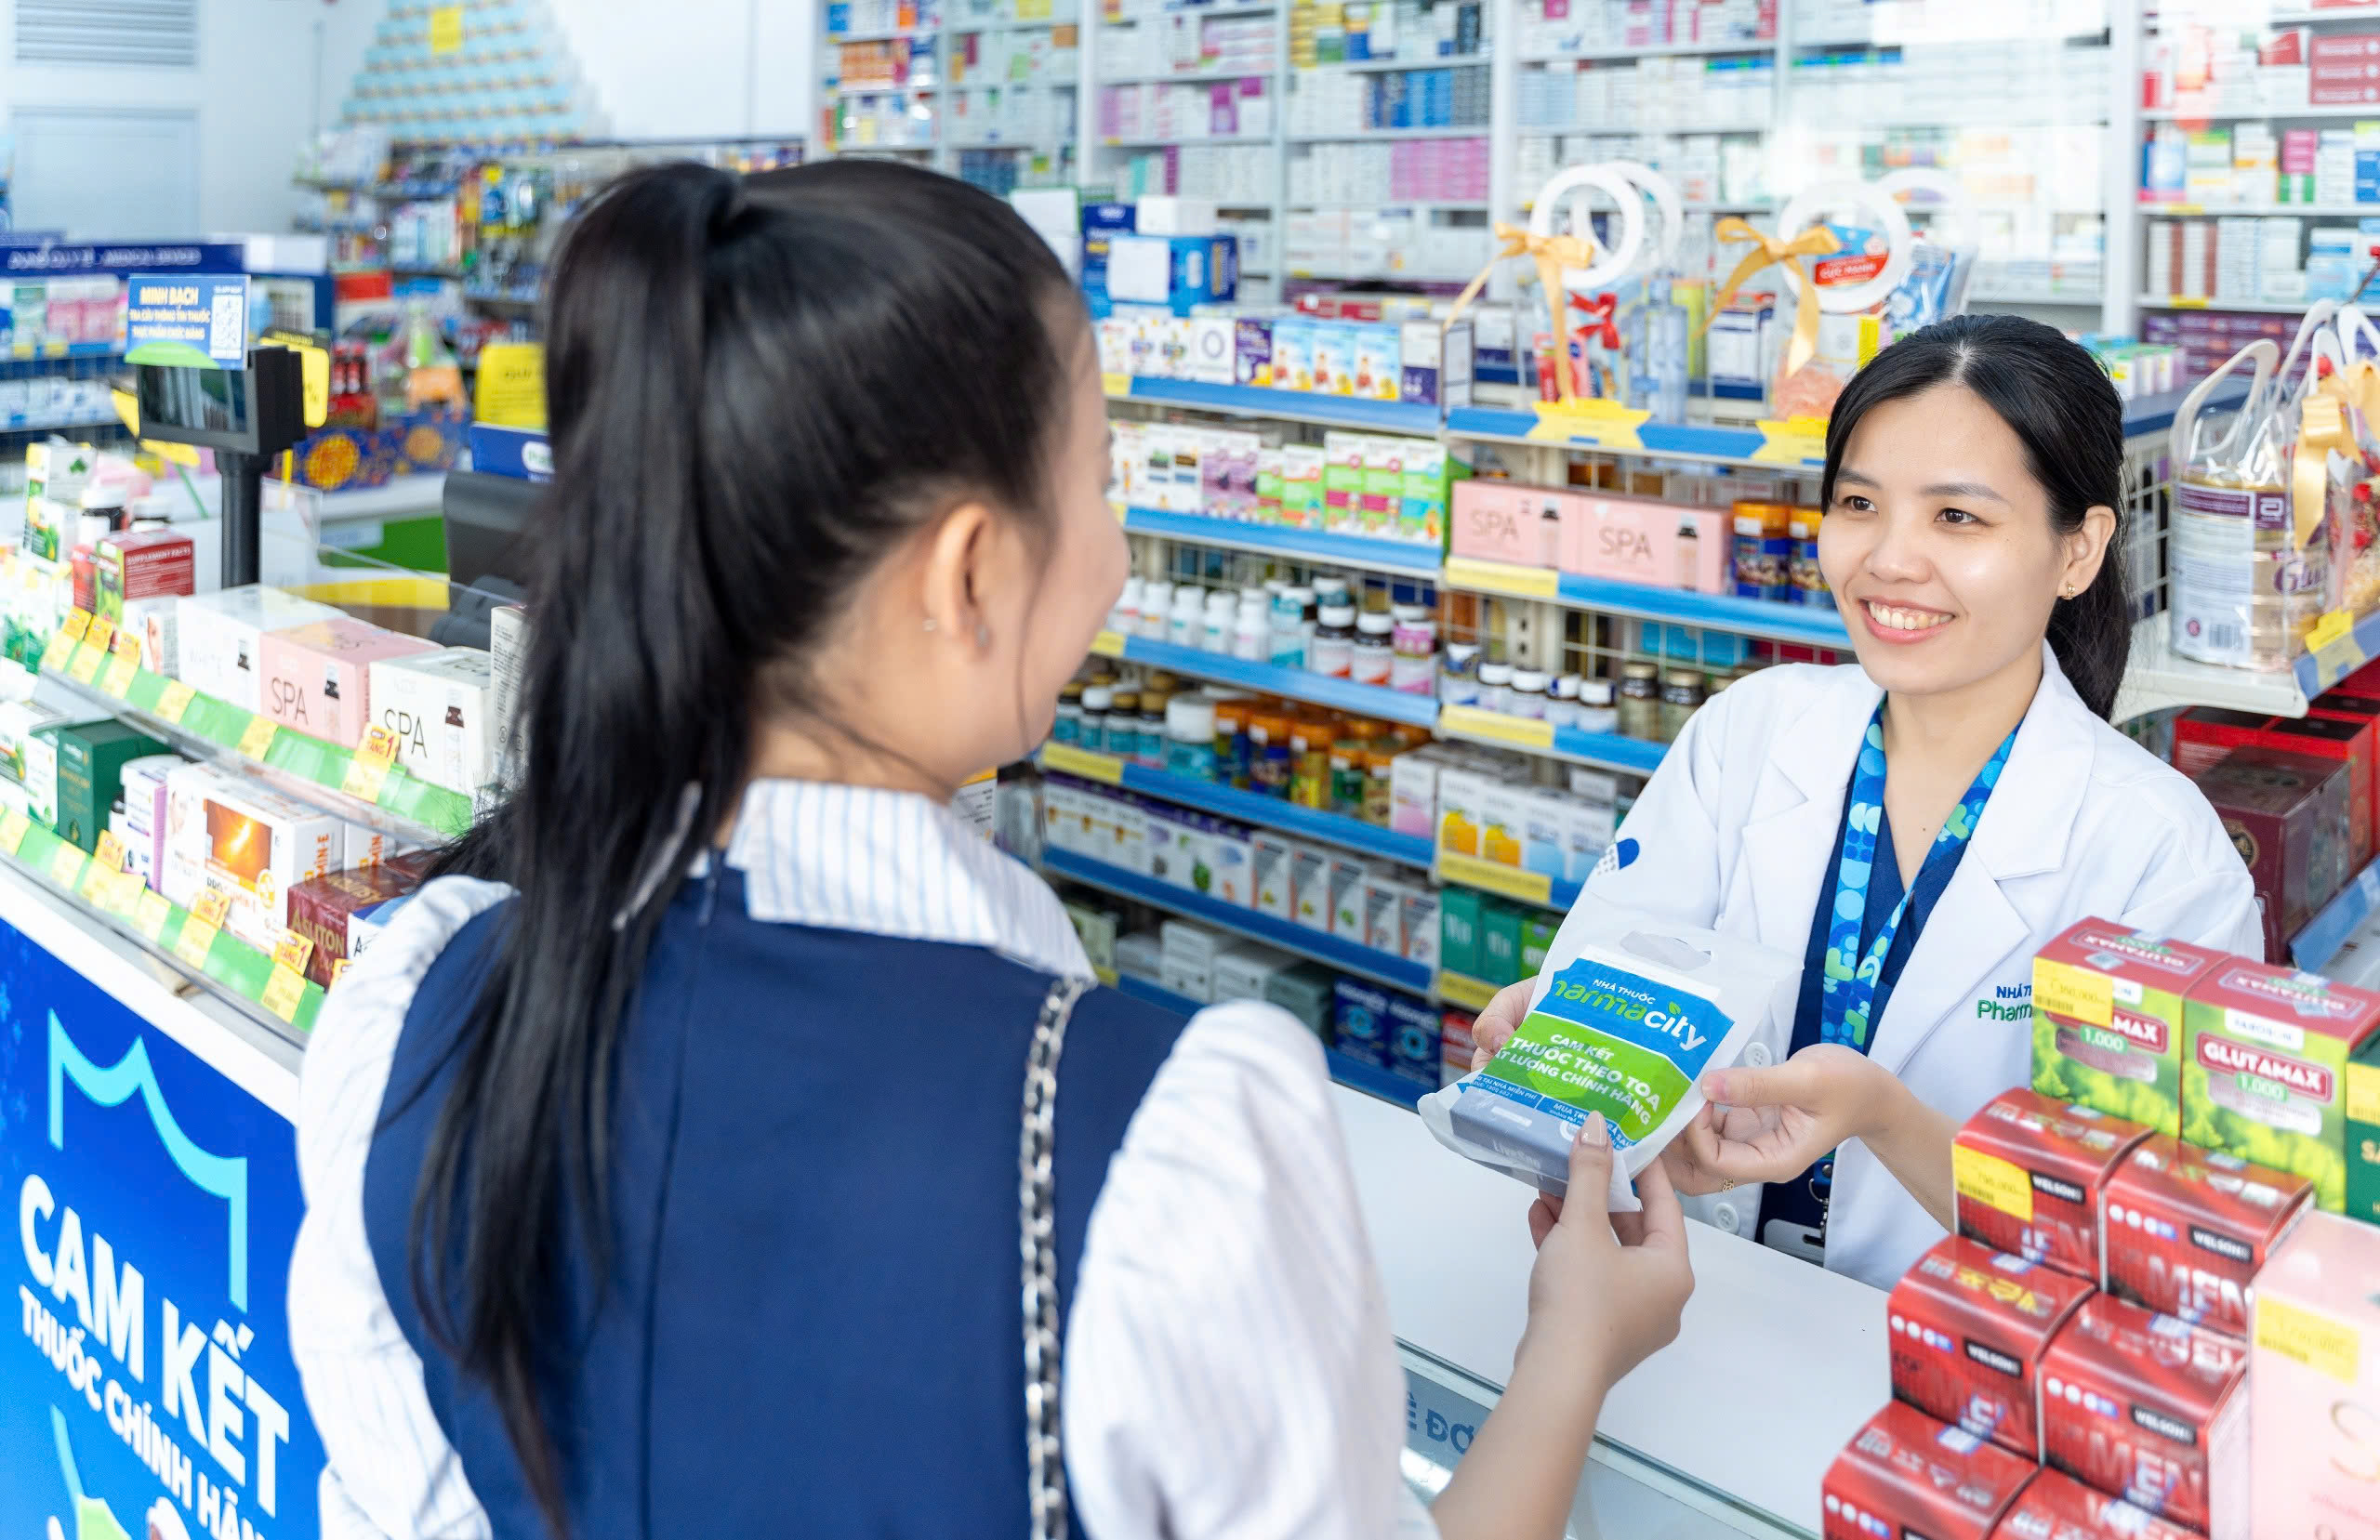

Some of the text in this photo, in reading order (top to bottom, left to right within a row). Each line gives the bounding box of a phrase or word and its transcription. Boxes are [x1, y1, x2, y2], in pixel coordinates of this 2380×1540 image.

[139, 286, 168, 305] MINH
[168, 287, 199, 308] BẠCH
[1470, 509, 1519, 541] SPA
[1598, 526, 1653, 560] SPA
[271, 677, 309, 726] SPA
[1593, 979, 1656, 1005] NHÀ THUỐC
[1555, 980, 1707, 1051] armacity
[1977, 999, 2033, 1021] Pharm
[1550, 1033, 1615, 1061] CAM KẾT
[2083, 1027, 2124, 1050] 1.000
[1511, 1036, 1660, 1112] THUỐC THEO TOA
[2203, 1042, 2322, 1090] GLUTAMAX
[1510, 1053, 1560, 1077] LƯỢNG
[1561, 1071, 1609, 1095] CHÍNH
[1609, 1089, 1651, 1125] HÀNG
[2241, 1074, 2284, 1099] 1.000
[1554, 1102, 1575, 1115] MUA
[20, 1174, 289, 1518] CAM KẾT
[19, 1284, 265, 1540] THUỐC CHÍNH HÀ
[1425, 1408, 1475, 1456] ĐƠ
